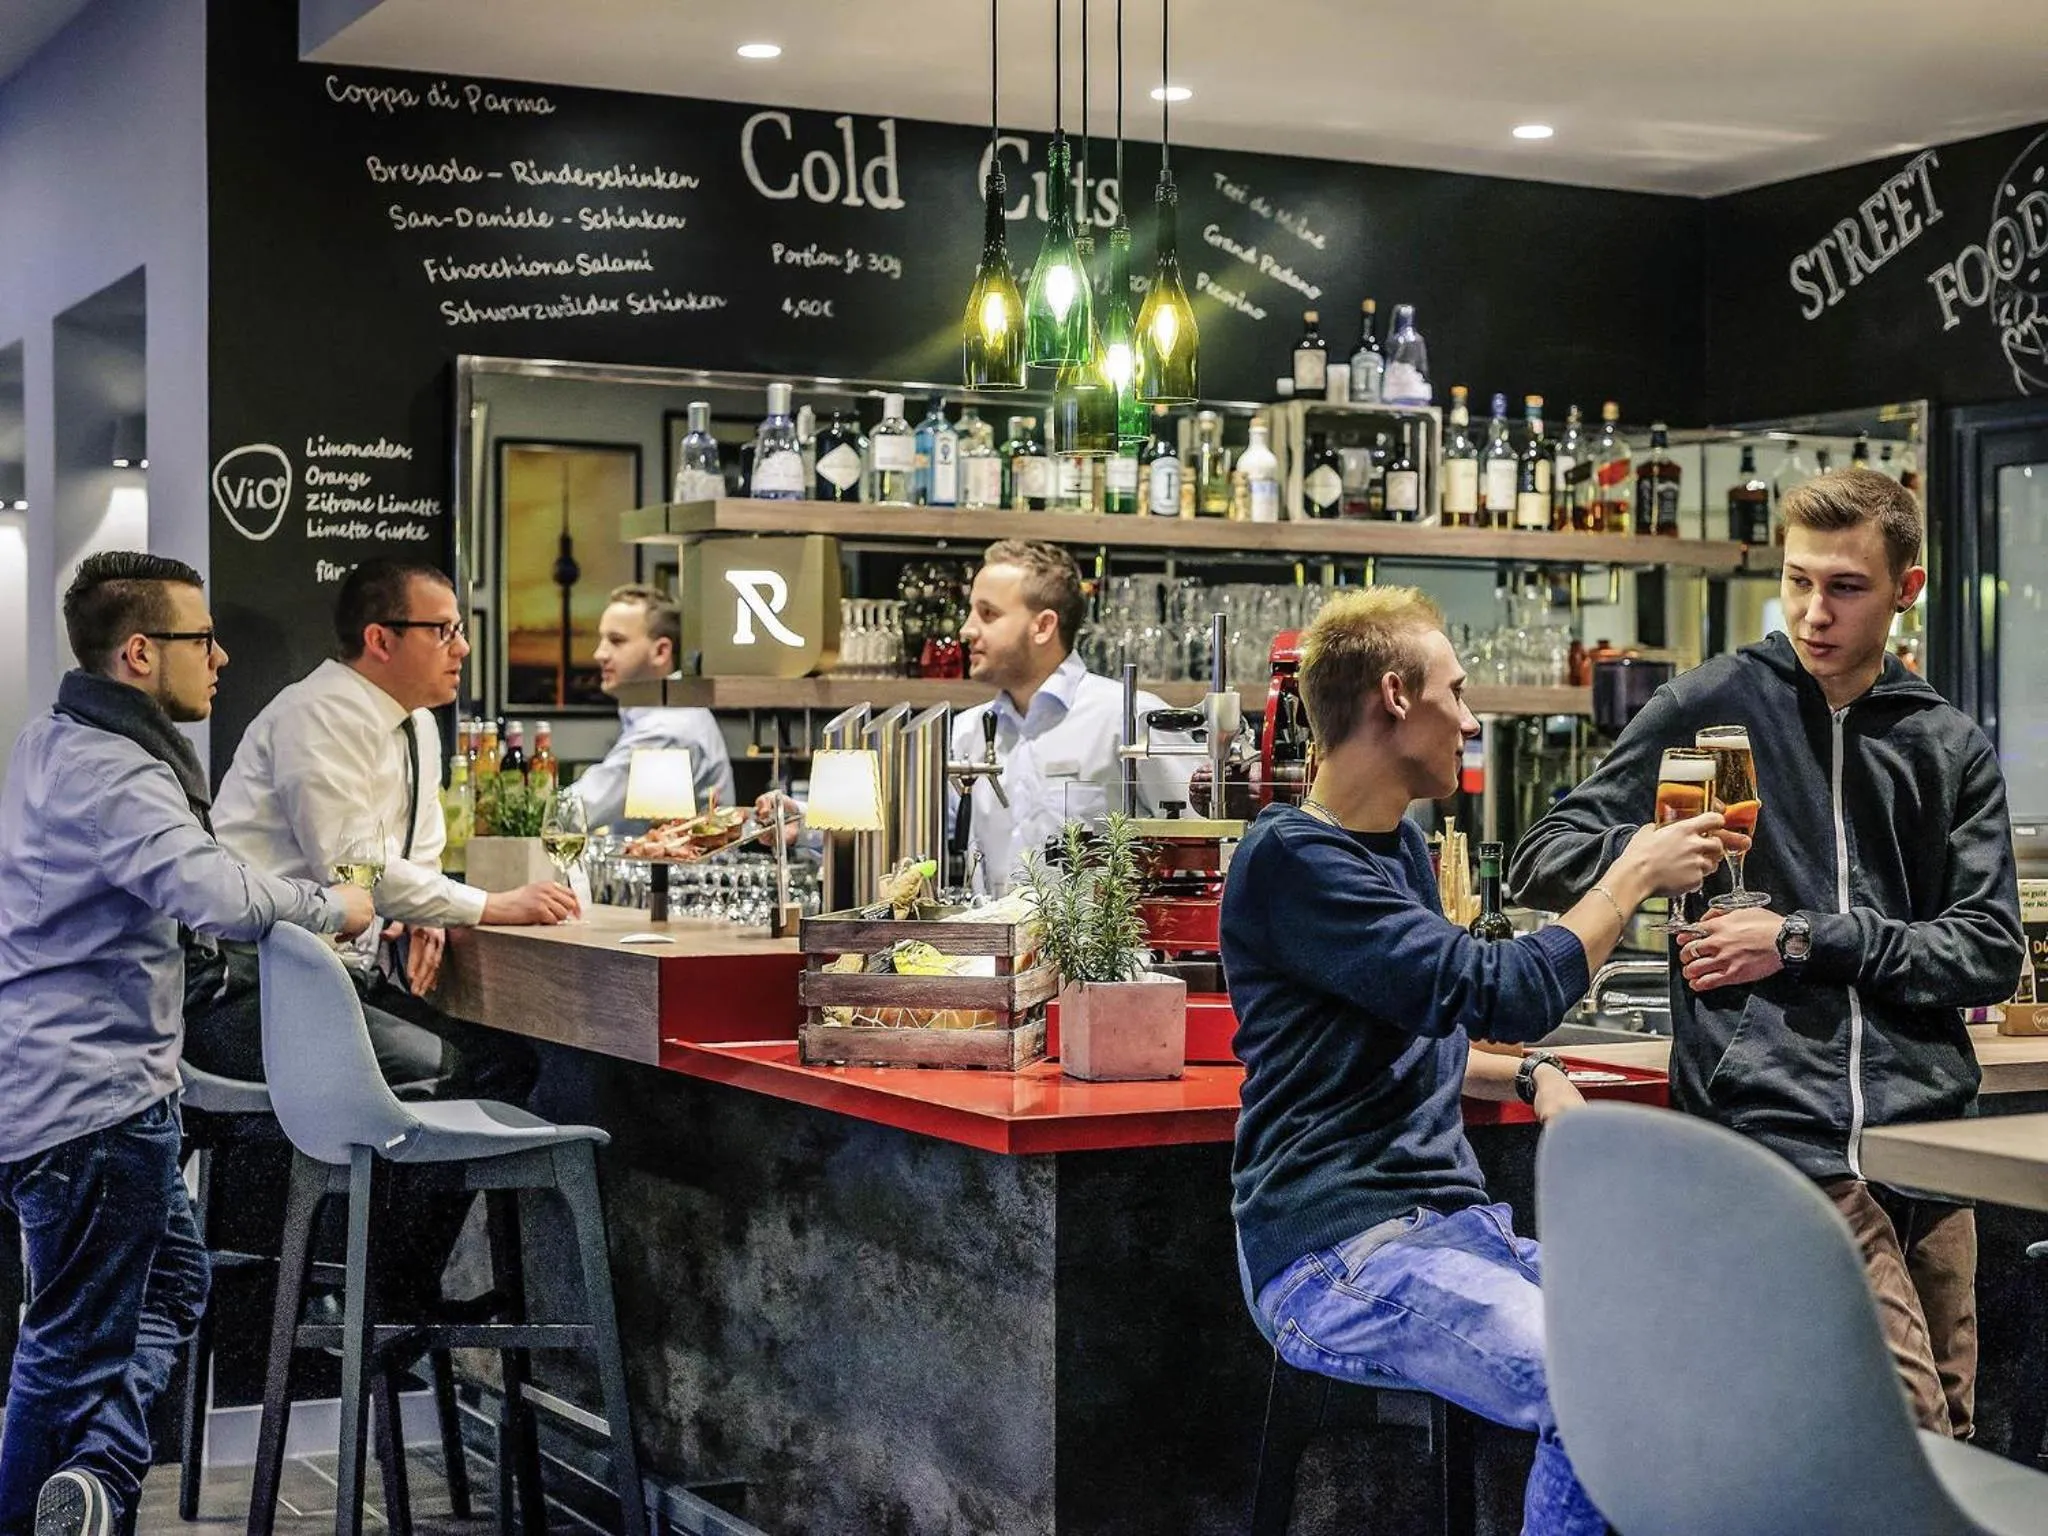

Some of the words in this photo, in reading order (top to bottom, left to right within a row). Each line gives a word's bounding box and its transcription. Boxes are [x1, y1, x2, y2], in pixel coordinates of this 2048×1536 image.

[325, 74, 421, 113] Coppa
[427, 80, 460, 110] di
[463, 84, 557, 115] Parma
[509, 159, 701, 191] Rinderschinken
[741, 111, 905, 210] Cold
[577, 205, 688, 232] Schinken
[1789, 149, 1943, 321] STREET
[575, 249, 655, 277] Salami
[771, 241, 843, 268] Portion
[843, 248, 863, 274] je
[866, 252, 903, 280] 30g
[439, 293, 620, 326] Schwarzwälder
[625, 286, 728, 316] Schinken
[304, 464, 372, 492] Orange
[305, 491, 376, 515] Zitrone
[377, 493, 442, 518] Limette
[305, 517, 374, 541] Limette
[374, 519, 431, 541] Gurke
[724, 569, 805, 648] R
